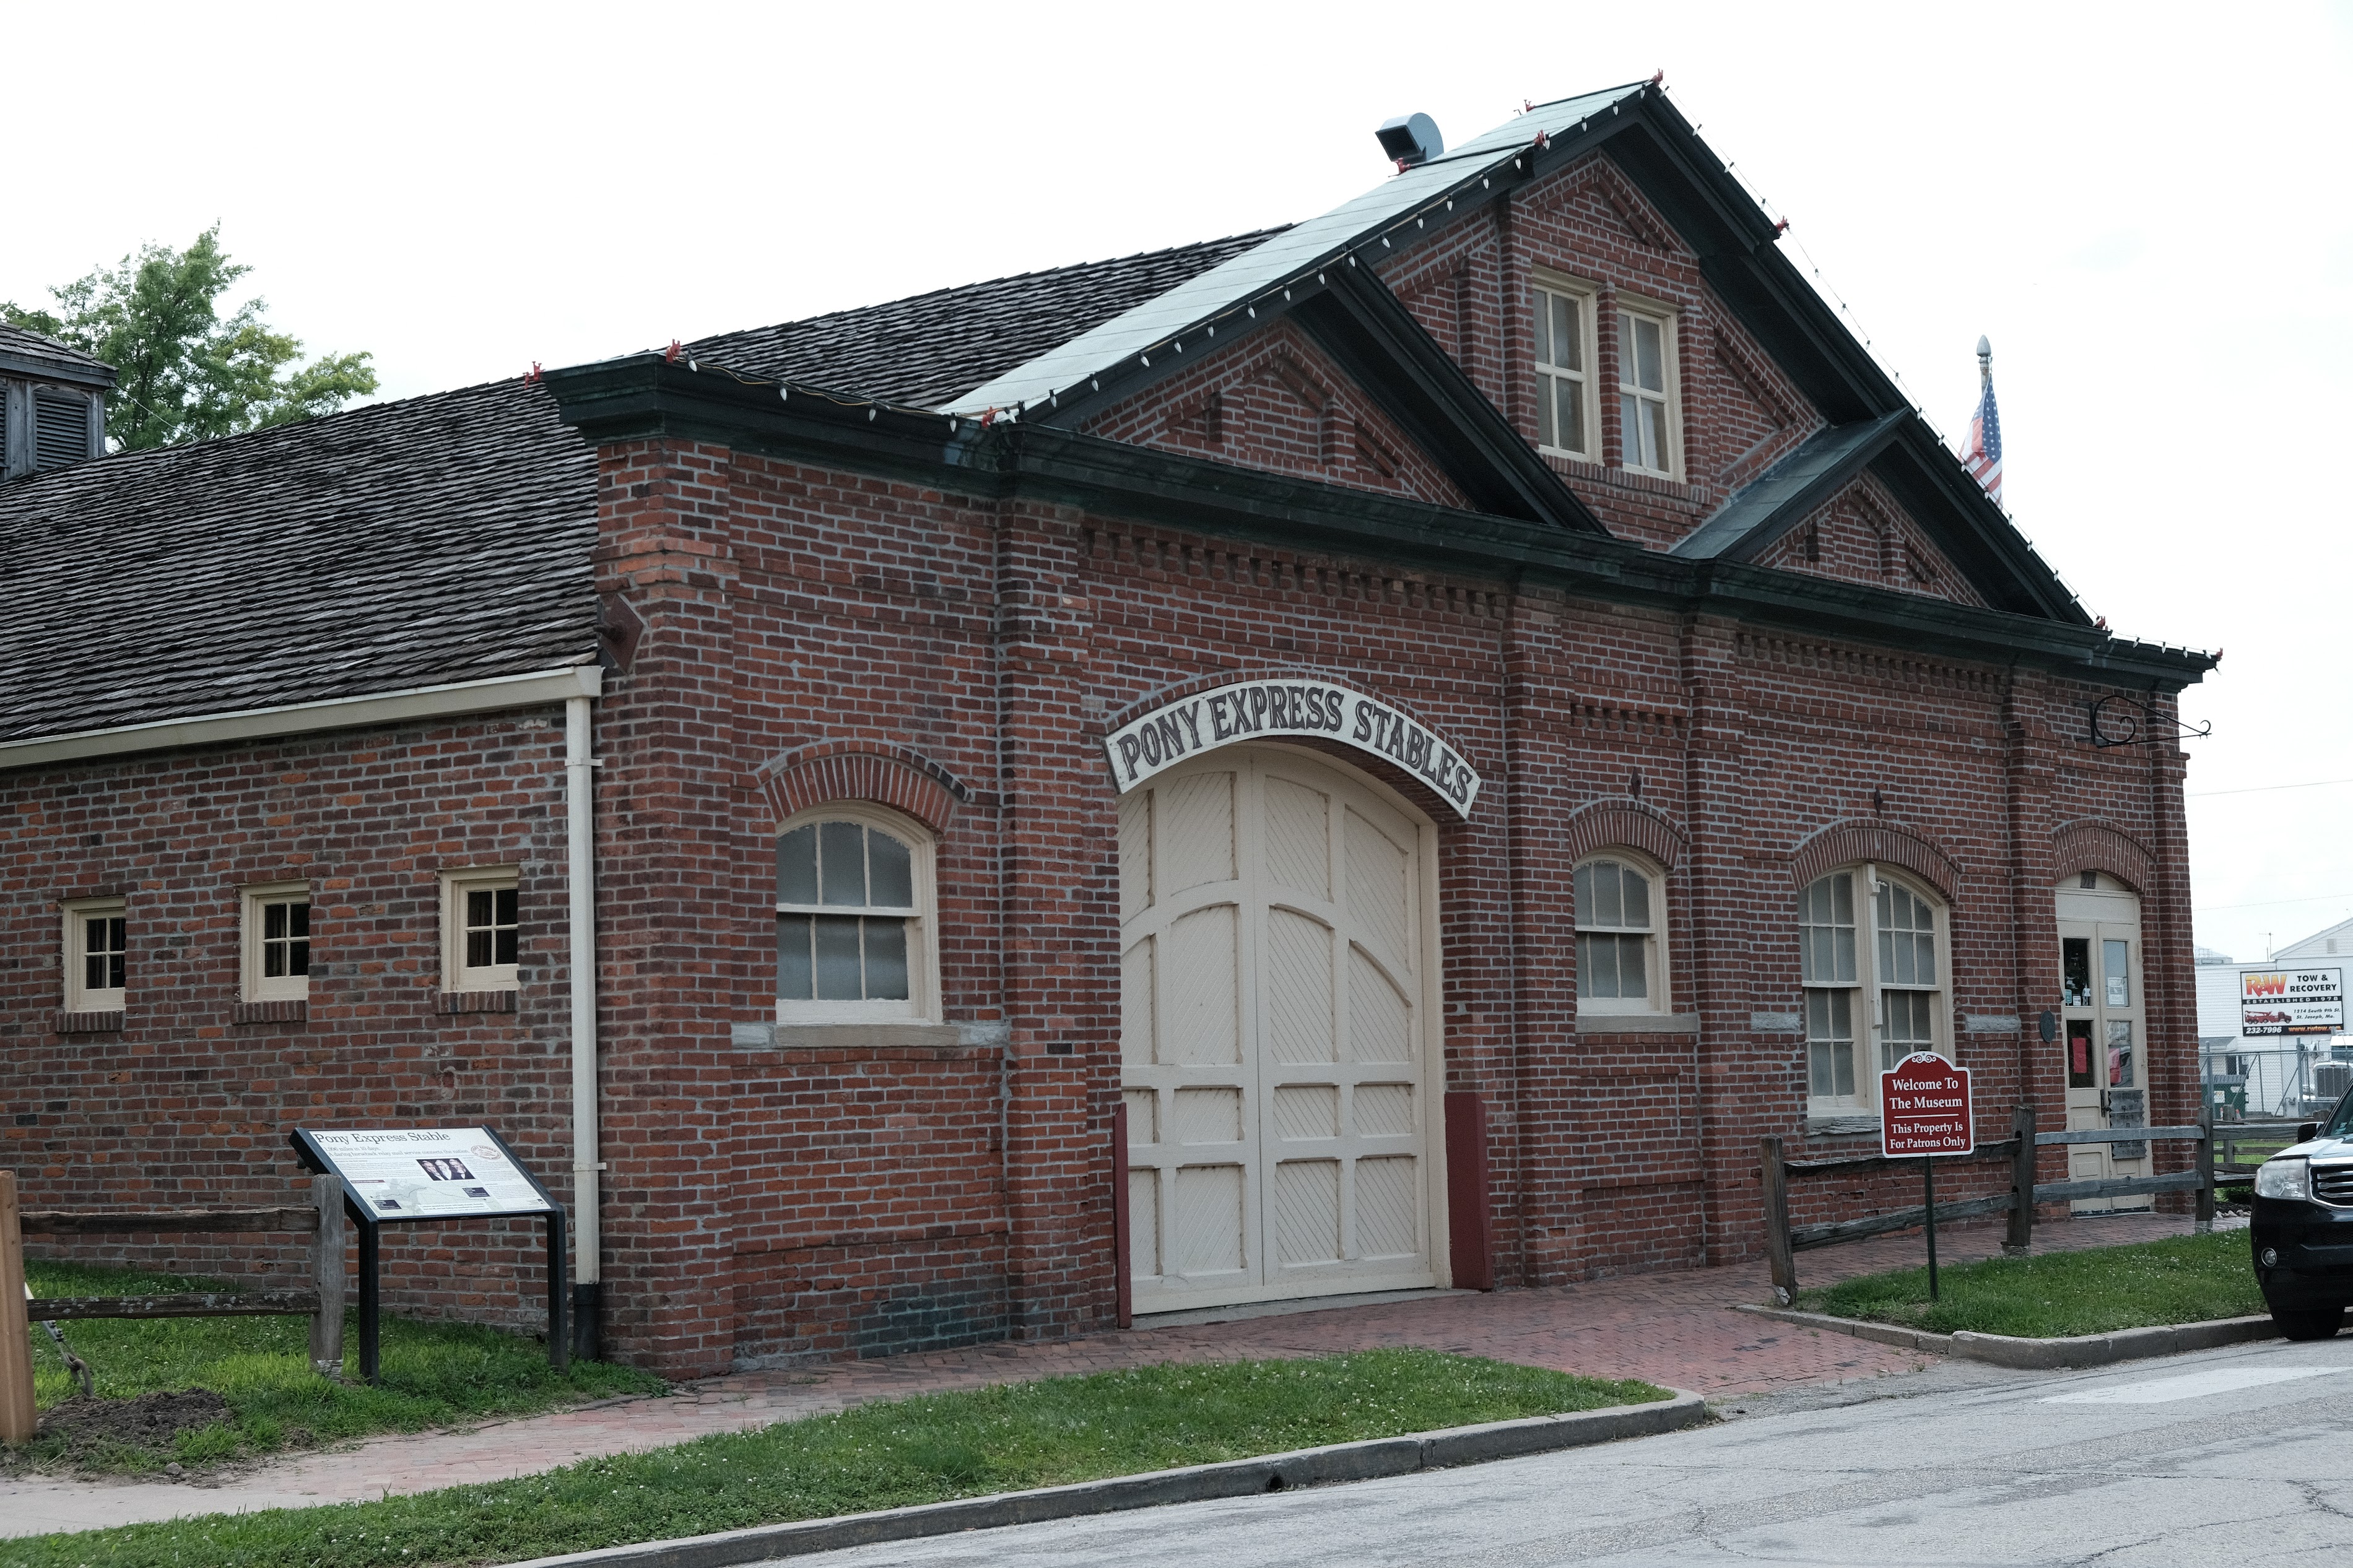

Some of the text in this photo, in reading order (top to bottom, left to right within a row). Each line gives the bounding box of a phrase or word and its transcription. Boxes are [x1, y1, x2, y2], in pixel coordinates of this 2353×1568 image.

[1116, 685, 1473, 805] PONY EXPRESS STABLES
[2290, 984, 2337, 992] RECOVERY
[1892, 1077, 1959, 1091] Welcome To
[1889, 1096, 1963, 1109] The Museum
[1891, 1121, 1964, 1135] This Property Is
[313, 1132, 451, 1145] Pony Express Stable
[1890, 1136, 1966, 1149] For Patrons Only
